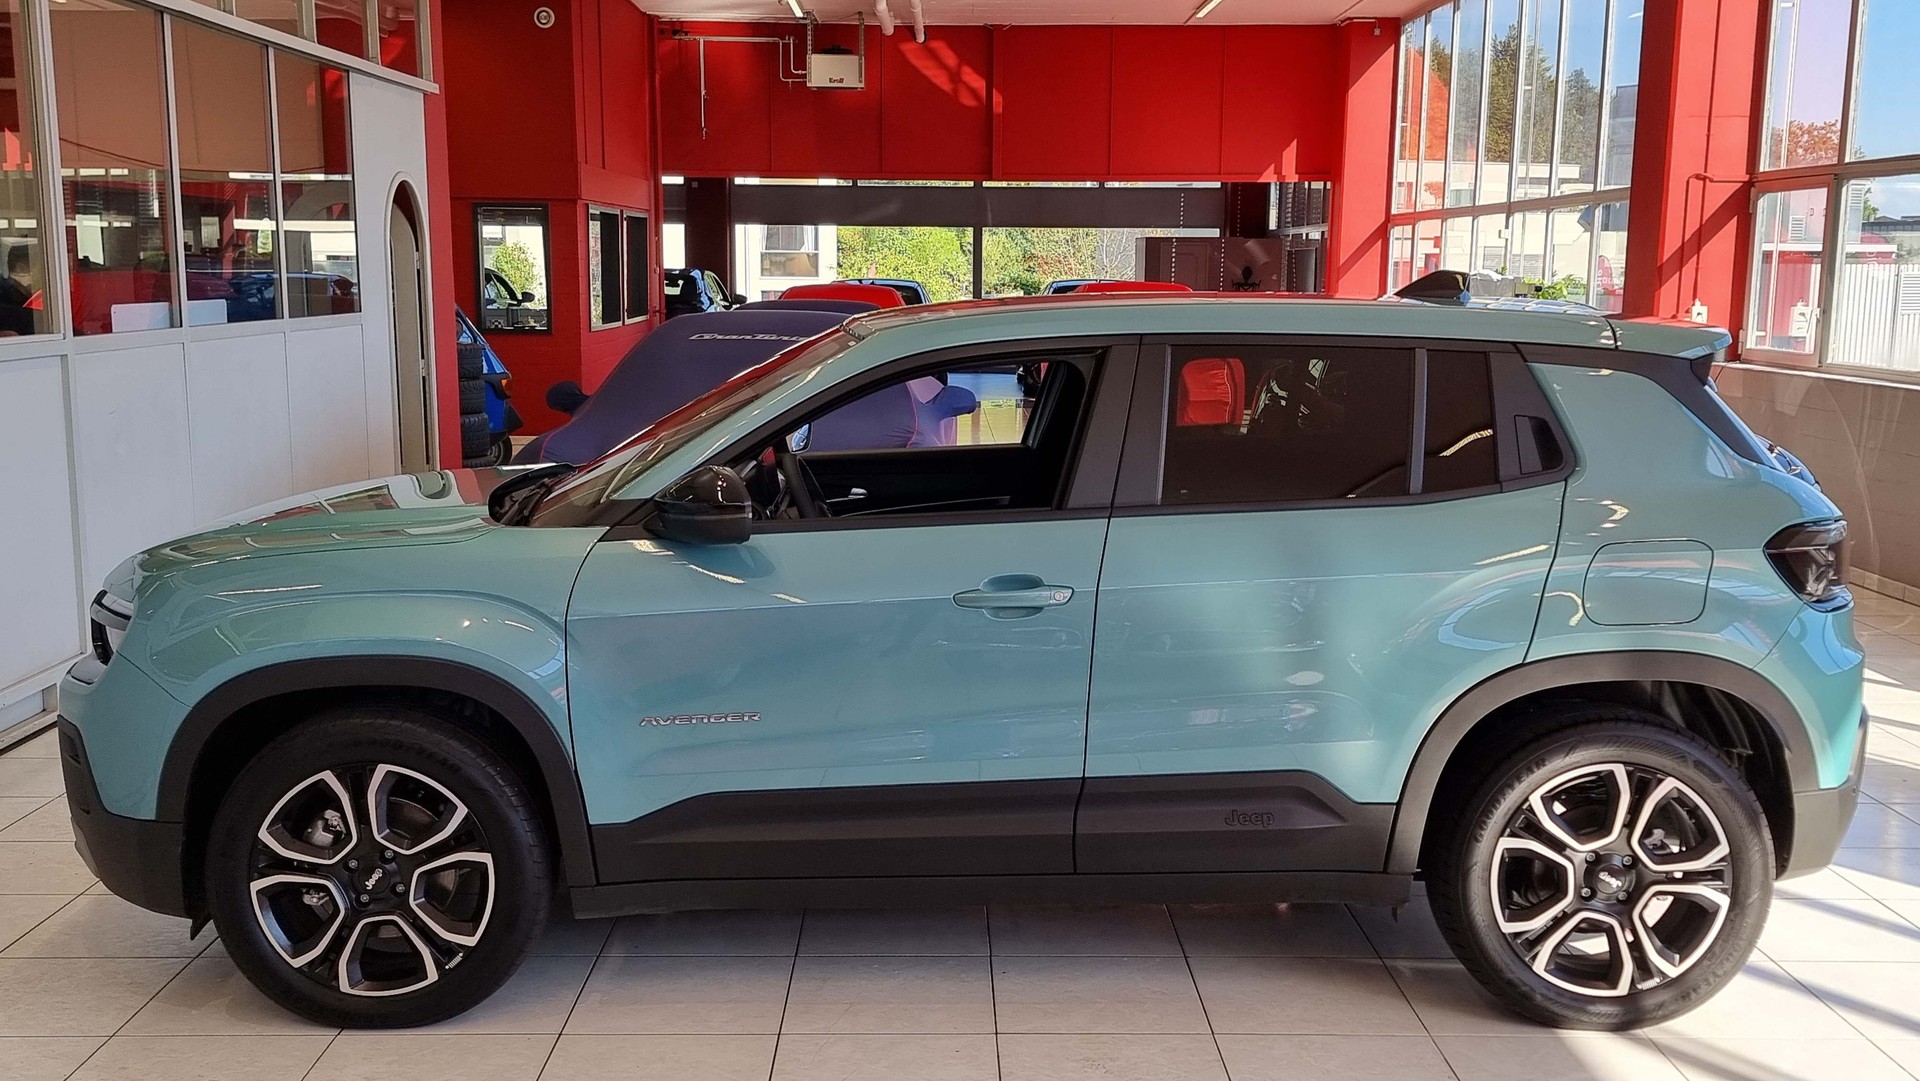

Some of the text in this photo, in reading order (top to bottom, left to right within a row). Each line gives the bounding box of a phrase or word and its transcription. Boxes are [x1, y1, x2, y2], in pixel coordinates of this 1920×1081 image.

[639, 711, 761, 727] AVENGER
[1224, 809, 1274, 828] Jeep
[364, 868, 383, 890] Jeep
[1598, 871, 1622, 889] Jeep
